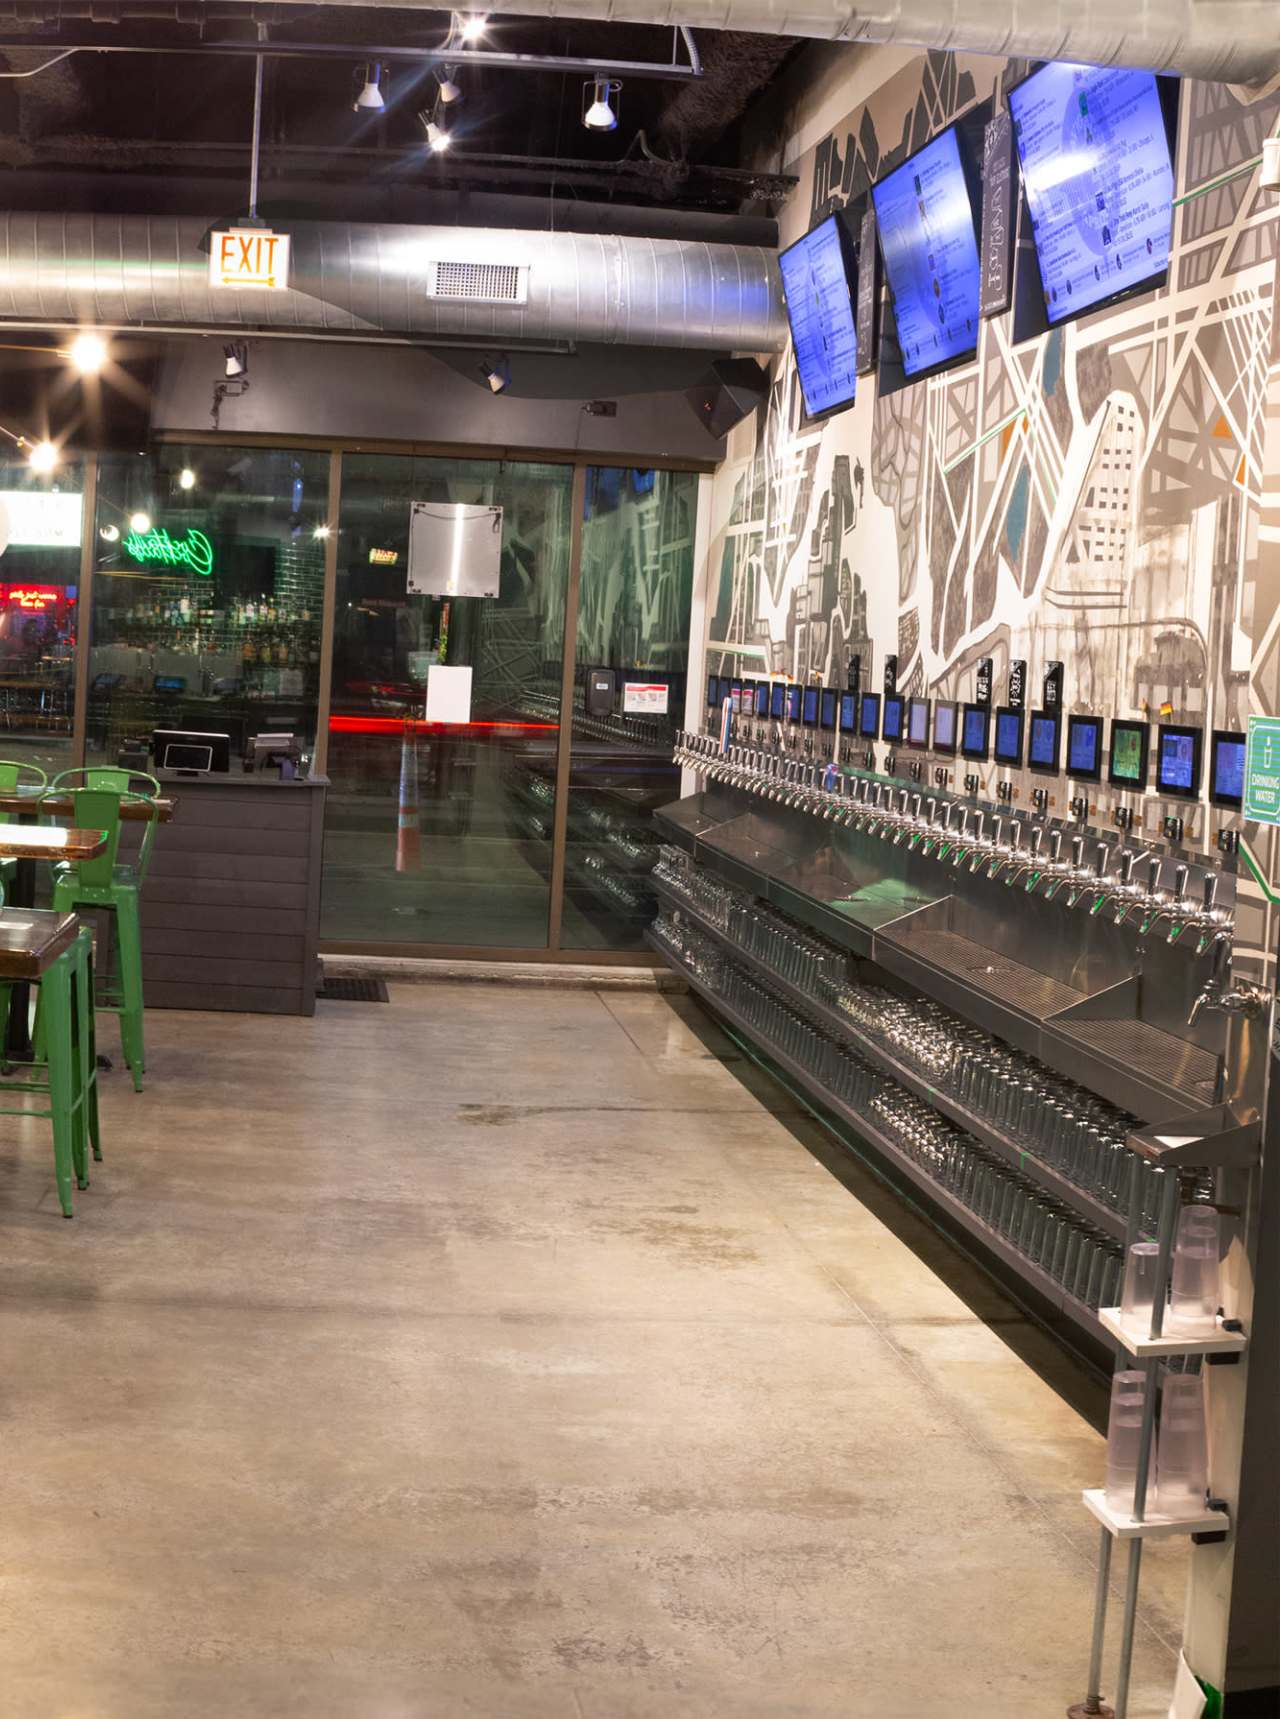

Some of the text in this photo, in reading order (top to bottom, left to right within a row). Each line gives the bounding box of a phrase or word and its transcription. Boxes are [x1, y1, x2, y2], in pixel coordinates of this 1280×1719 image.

[220, 235, 279, 275] EXIT
[1252, 774, 1280, 789] DRINKING
[1255, 789, 1275, 804] WATER
